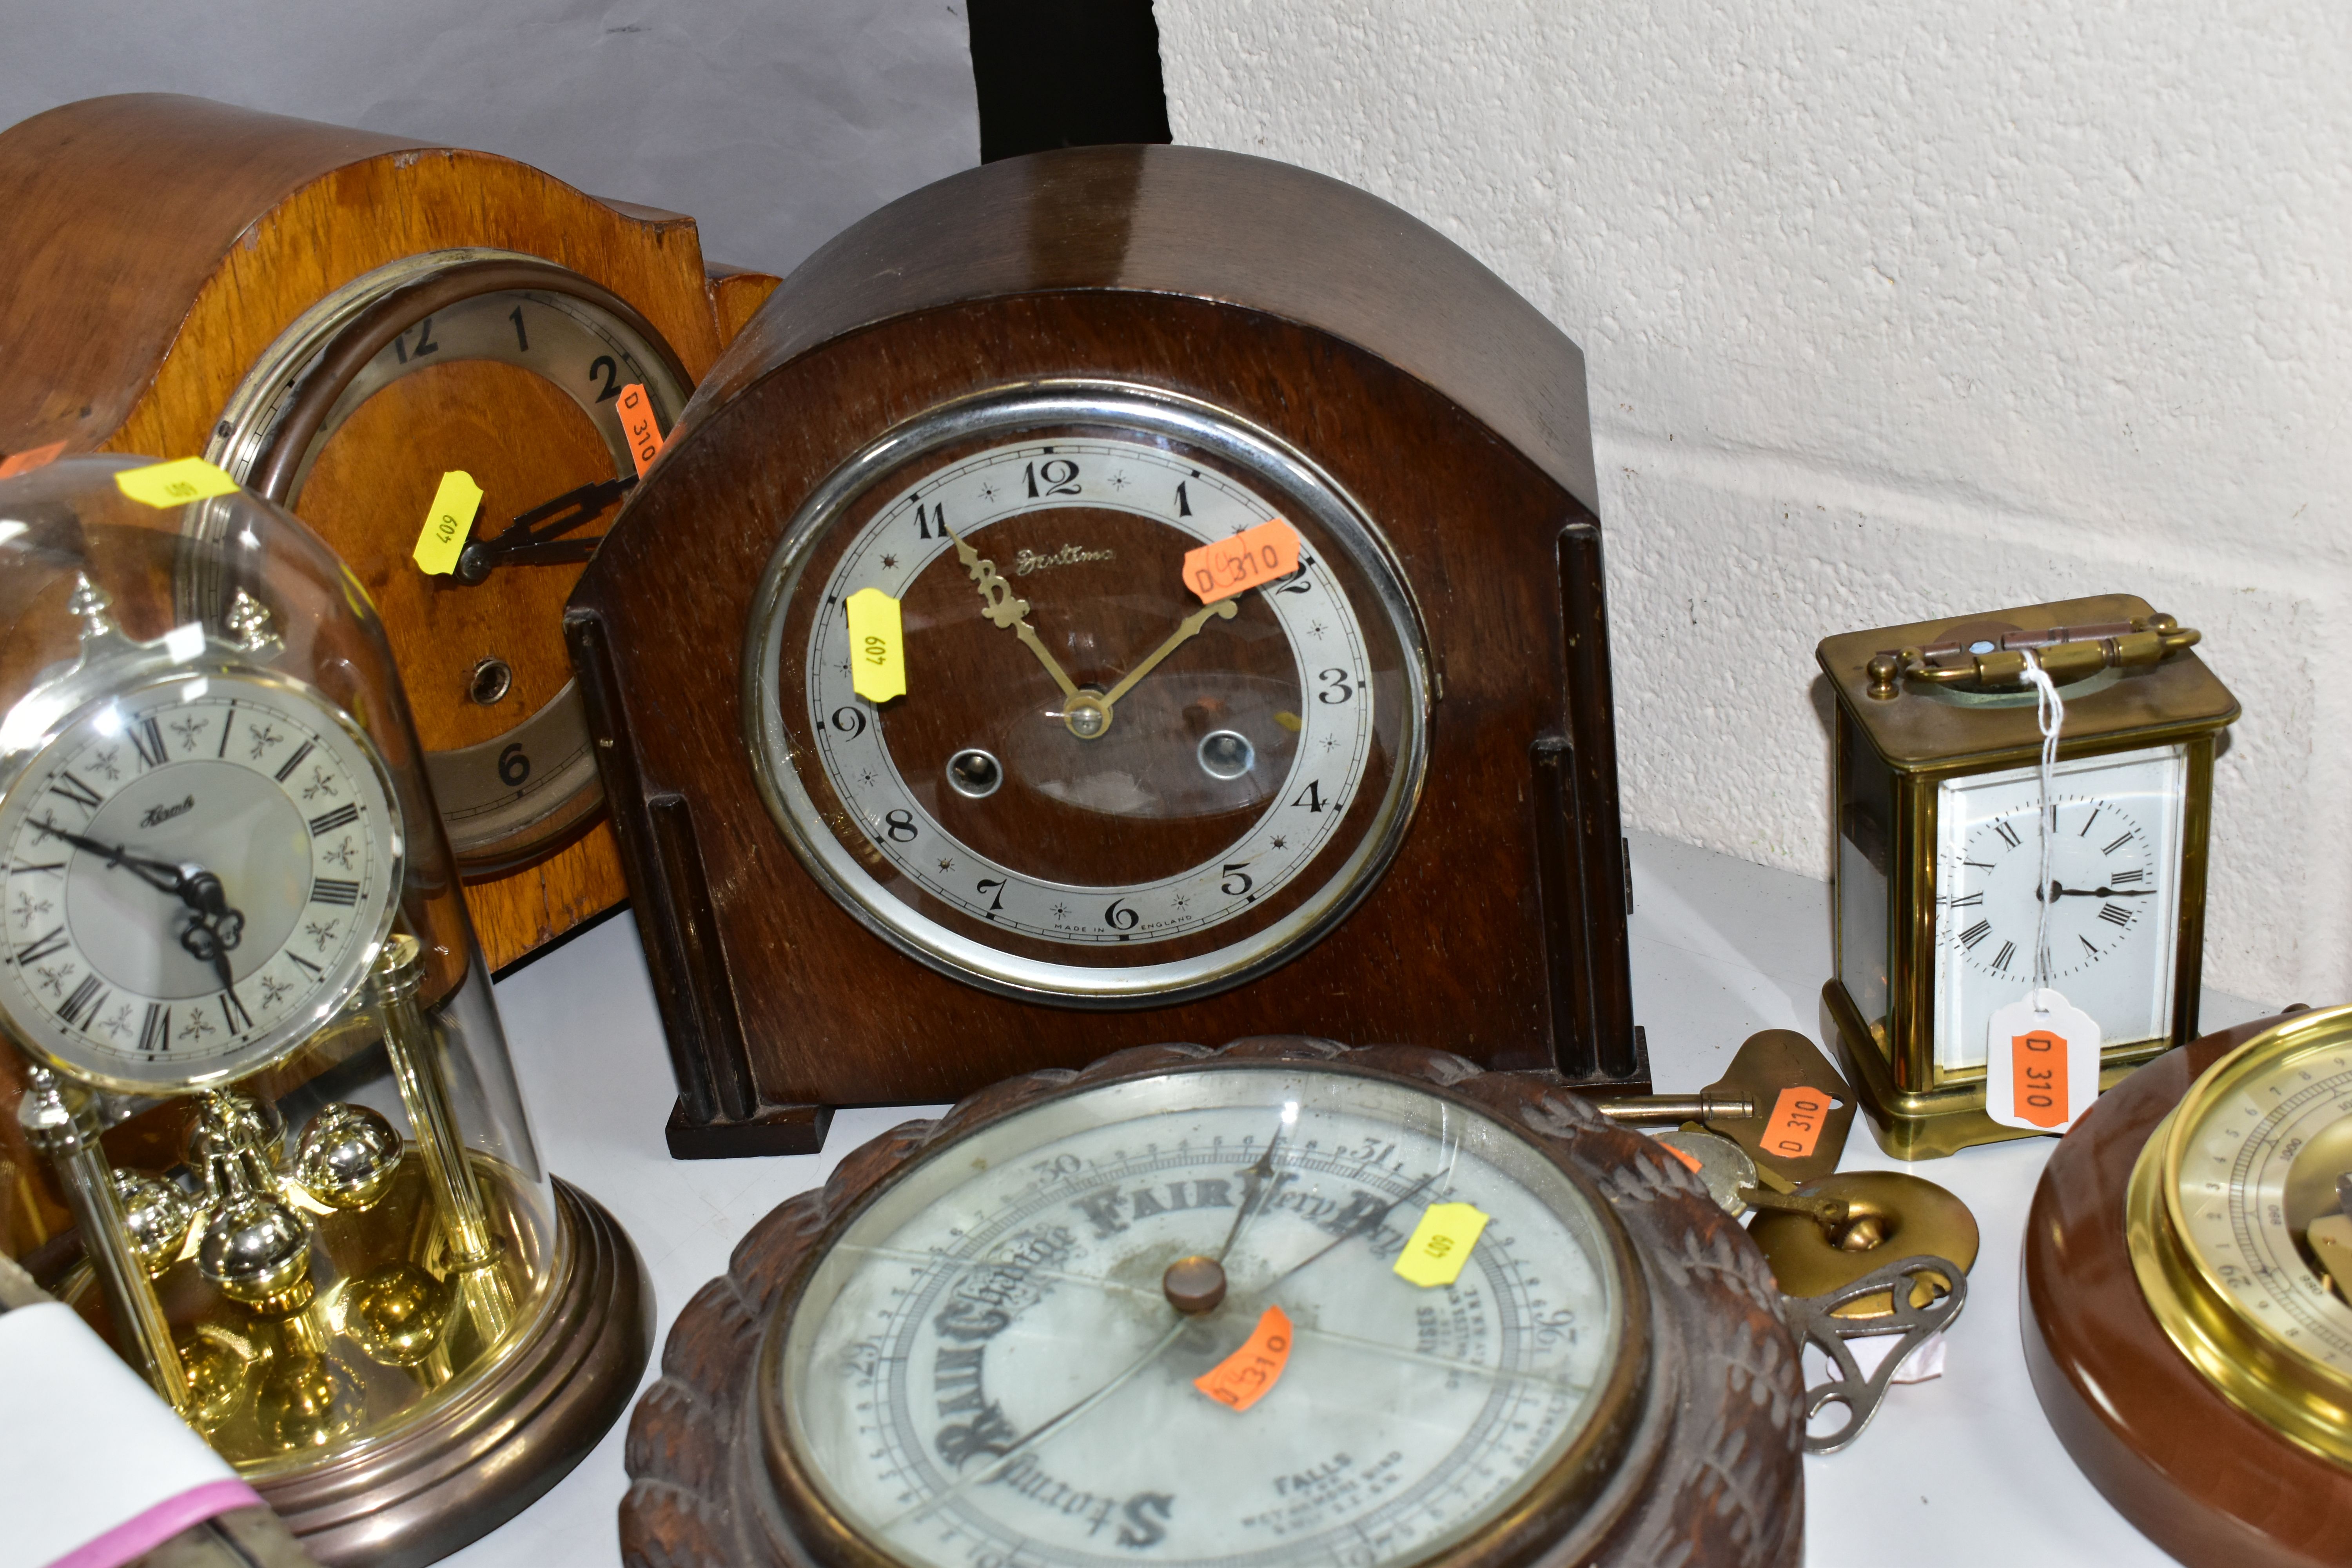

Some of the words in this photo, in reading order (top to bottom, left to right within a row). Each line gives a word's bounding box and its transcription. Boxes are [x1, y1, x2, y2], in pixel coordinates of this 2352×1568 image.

[508, 307, 528, 351] 1
[590, 356, 622, 404] 2
[624, 392, 639, 409] D
[633, 419, 656, 461] 310
[1022, 459, 1082, 498] 12
[1174, 481, 1192, 517] 1
[436, 514, 459, 546] 409
[914, 502, 950, 539] 11
[1195, 569, 1214, 593] D
[1228, 545, 1279, 581] 310
[865, 636, 886, 666] 409
[1318, 667, 1353, 704] 3
[832, 707, 866, 742] 9
[275, 739, 315, 782] II
[499, 743, 529, 786] 6
[1292, 779, 1329, 813] 4
[309, 802, 359, 837] III
[885, 809, 919, 842] 8
[2078, 808, 2100, 837] I
[1994, 820, 2023, 853] XI
[2101, 831, 2134, 856] II
[310, 877, 360, 906] IIII
[976, 877, 1005, 911] 7
[1221, 862, 1253, 896] 5
[2111, 868, 2143, 887] III
[1054, 923, 1086, 932] MADE
[1141, 915, 1192, 931] ENGLAND
[1105, 898, 1139, 930] 6
[2096, 902, 2133, 927] IIII
[1988, 940, 2017, 971] VII
[2078, 934, 2099, 958] V
[285, 948, 323, 982] V
[2026, 1038, 2051, 1052] D
[2027, 1067, 2052, 1107] 310
[2269, 1086, 2282, 1096] 7
[1786, 1100, 1819, 1132] 310
[2244, 1107, 2258, 1116] 6
[1351, 1138, 1395, 1161] 31
[1779, 1138, 1803, 1153] D
[2225, 1129, 2239, 1138] 5
[2279, 1138, 2301, 1161] 1000
[1031, 1154, 1081, 1183] 30
[1069, 1179, 1235, 1239] FAIR
[1424, 1234, 1455, 1259] 409
[1238, 1335, 1286, 1386] 310
[935, 1345, 1017, 1474] RAIN
[1273, 1452, 1352, 1496] FALLS
